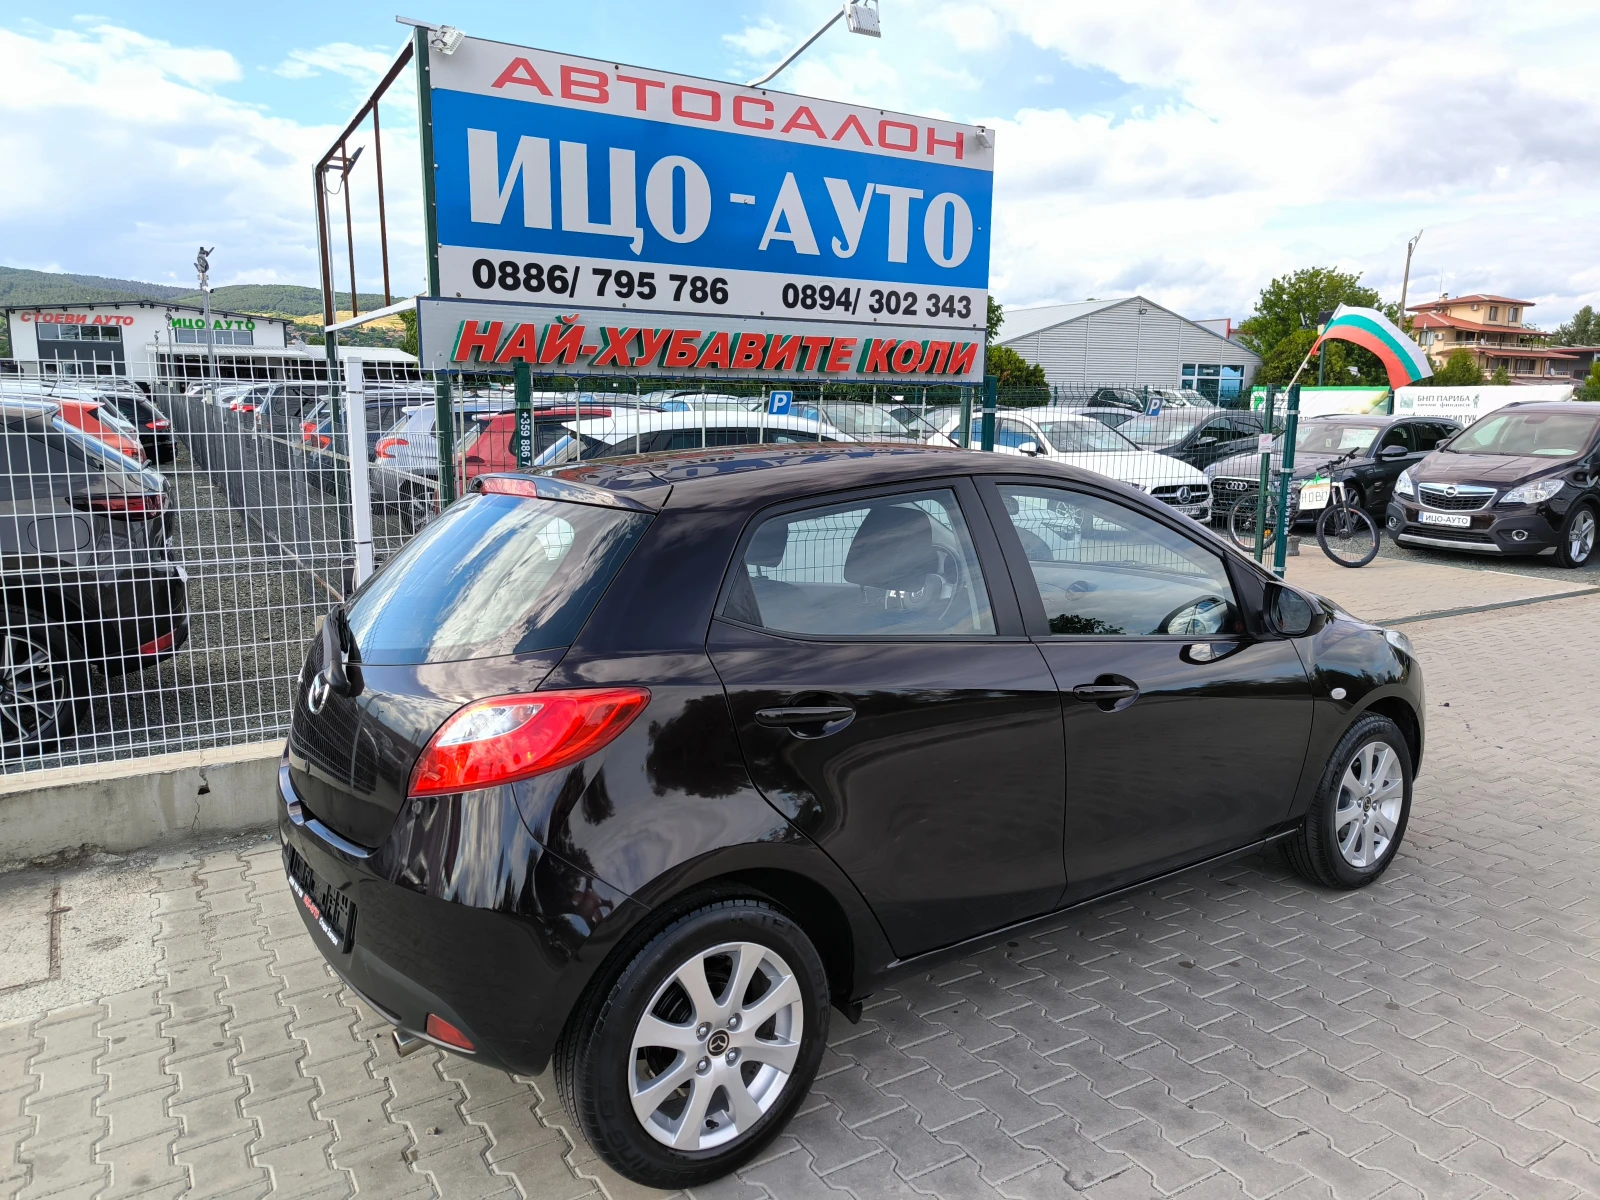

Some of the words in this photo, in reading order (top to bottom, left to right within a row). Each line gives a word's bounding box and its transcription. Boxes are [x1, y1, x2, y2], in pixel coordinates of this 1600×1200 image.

[492, 57, 965, 160] АВТОСАЛОН
[467, 128, 712, 256] ИЦО
[758, 172, 973, 268] АУТО
[472, 258, 581, 299] 0886/
[592, 267, 657, 301] 795
[669, 273, 729, 305] 786
[781, 282, 862, 316] 0894/
[868, 289, 918, 316] 302
[925, 293, 972, 319] 343
[20, 311, 88, 325] СТОЕВИ
[92, 314, 135, 327] АУТО
[171, 317, 206, 330] ИЦО
[213, 319, 256, 331] АУТО
[451, 312, 858, 373] НАЙ-ХУБАВИТЕ
[857, 337, 979, 375] КОЛИ
[520, 411, 531, 437] +359
[520, 439, 531, 458] 886
[1425, 514, 1469, 525] ИЦО-АУТО
